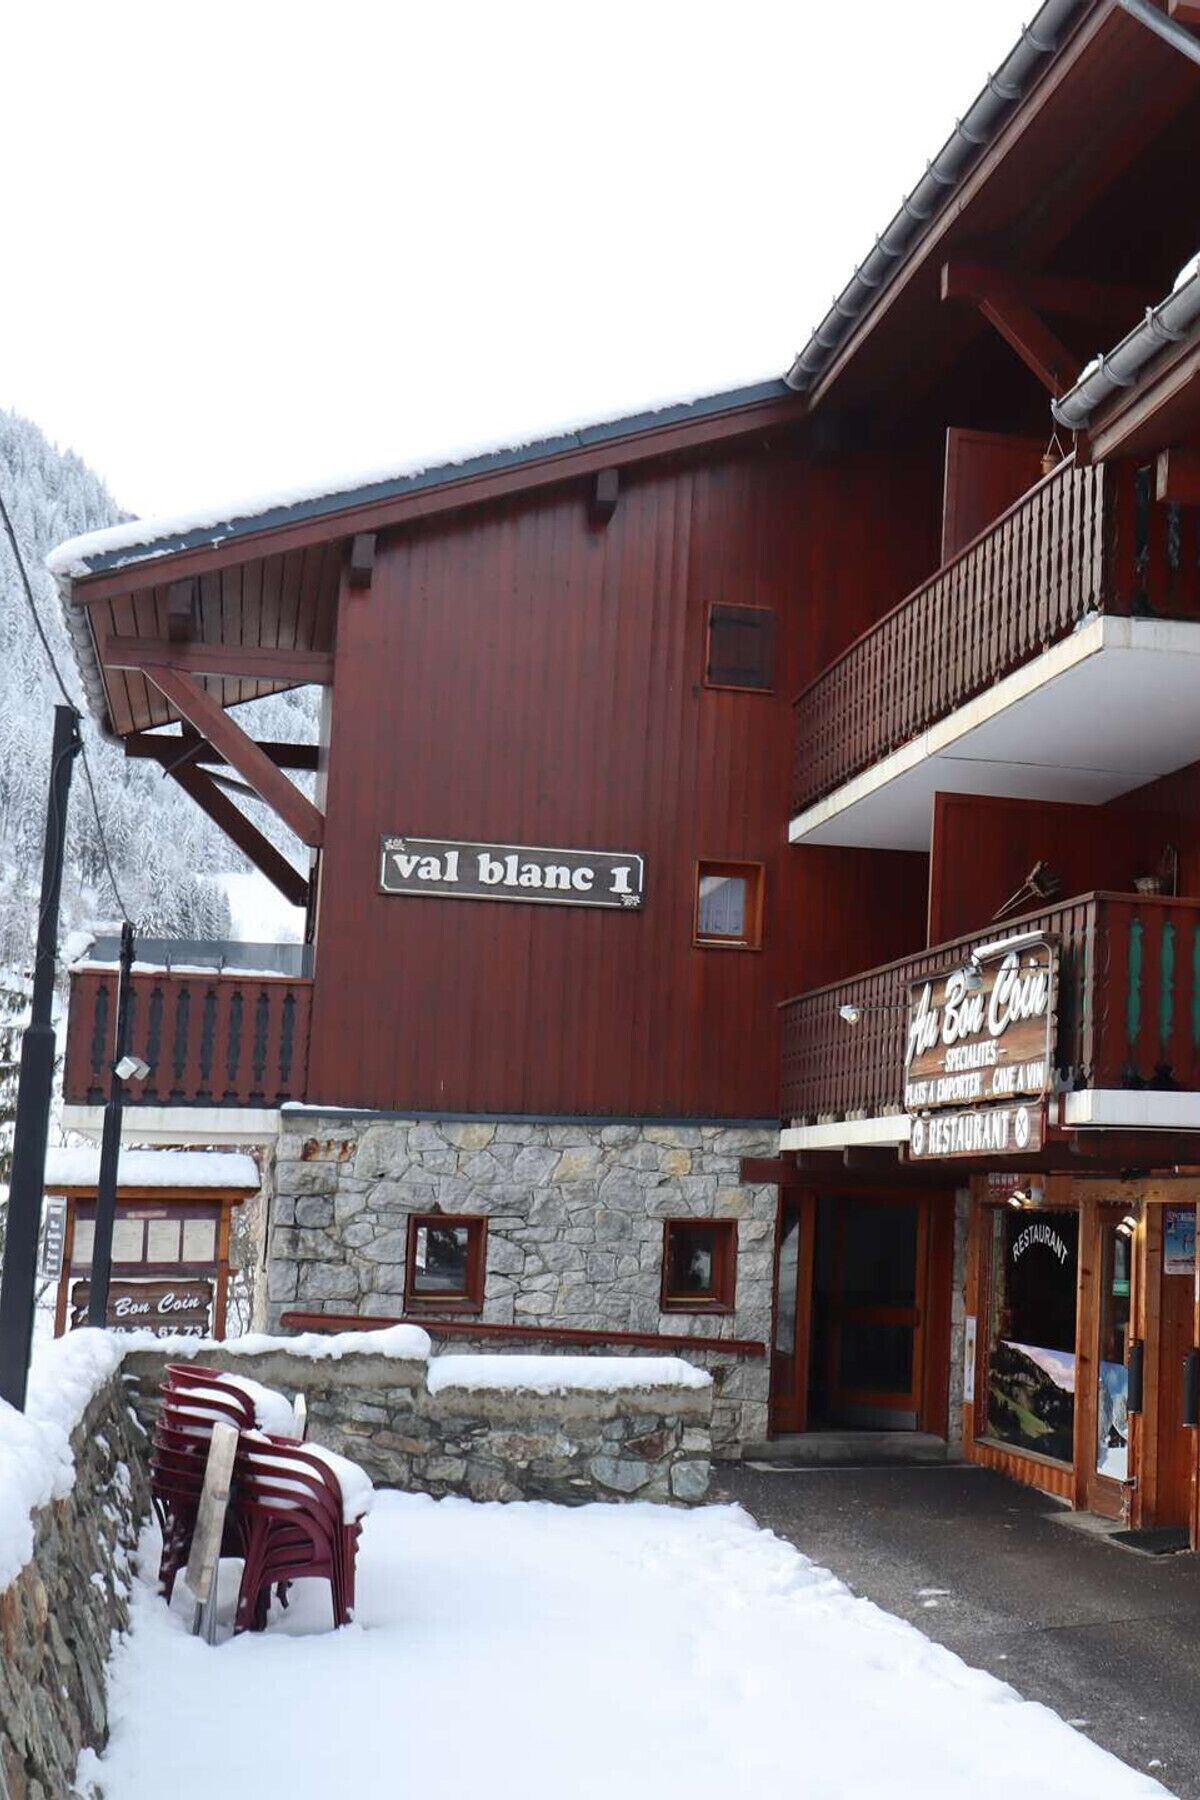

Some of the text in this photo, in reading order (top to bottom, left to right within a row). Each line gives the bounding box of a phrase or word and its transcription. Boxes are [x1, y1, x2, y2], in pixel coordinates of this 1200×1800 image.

[392, 851, 633, 893] val blanc 1
[905, 952, 1048, 1066] Au Bon Coin
[1027, 1061, 1044, 1089] VIN
[928, 1111, 1009, 1153] RESTAURANT
[1012, 1223, 1069, 1265] RESTAURANT
[114, 1297, 150, 1317] Bon
[157, 1292, 201, 1313] Coin
